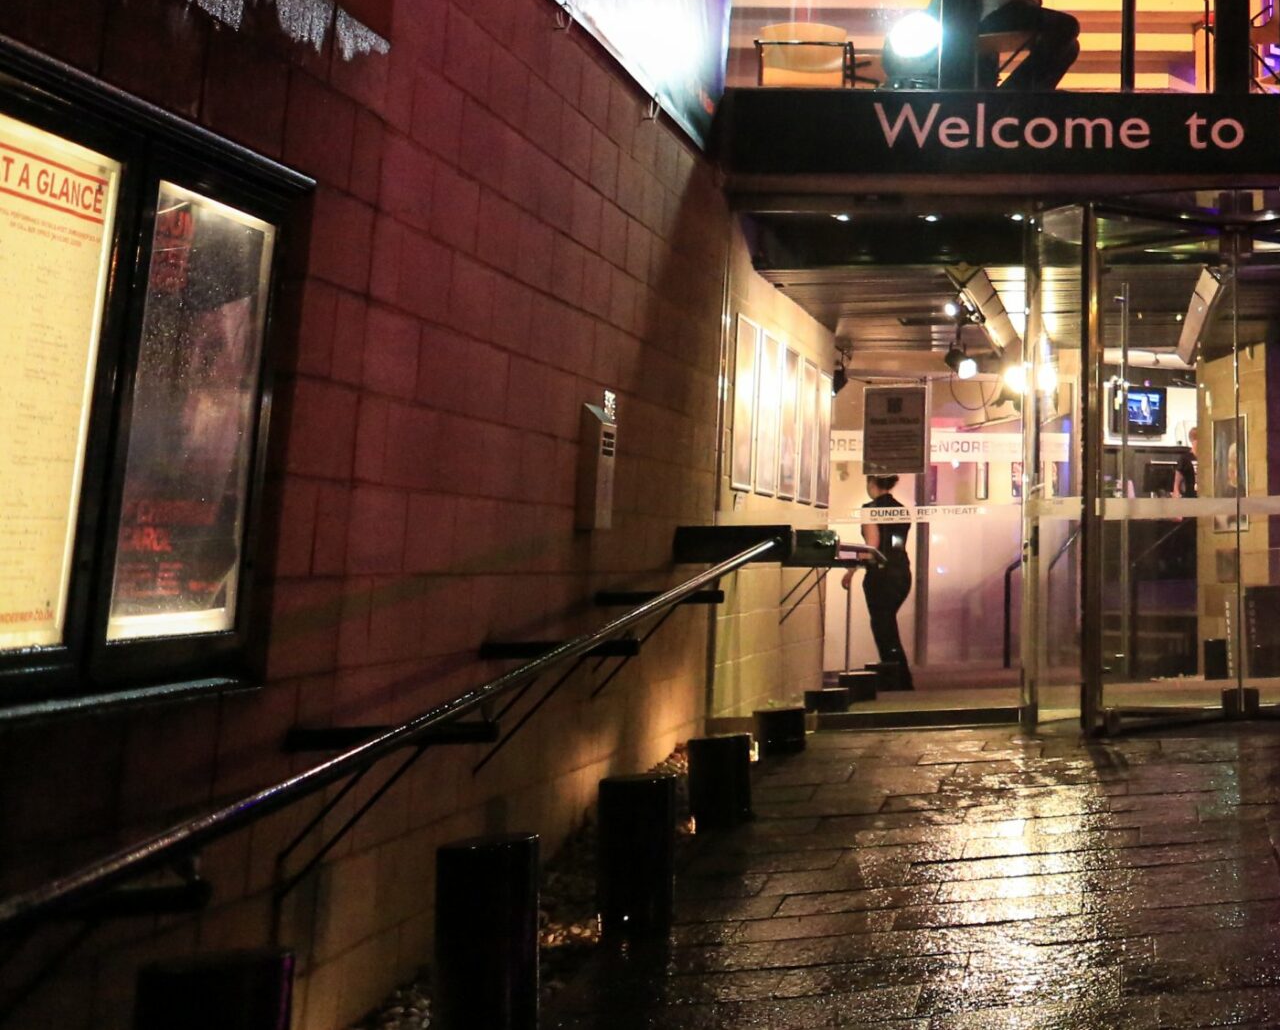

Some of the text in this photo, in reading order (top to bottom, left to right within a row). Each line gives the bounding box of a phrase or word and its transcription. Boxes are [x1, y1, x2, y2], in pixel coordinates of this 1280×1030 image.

[873, 102, 1150, 149] Welcome
[1186, 110, 1244, 149] to
[0, 156, 104, 214] T A GLANCE
[829, 438, 857, 452] ORE
